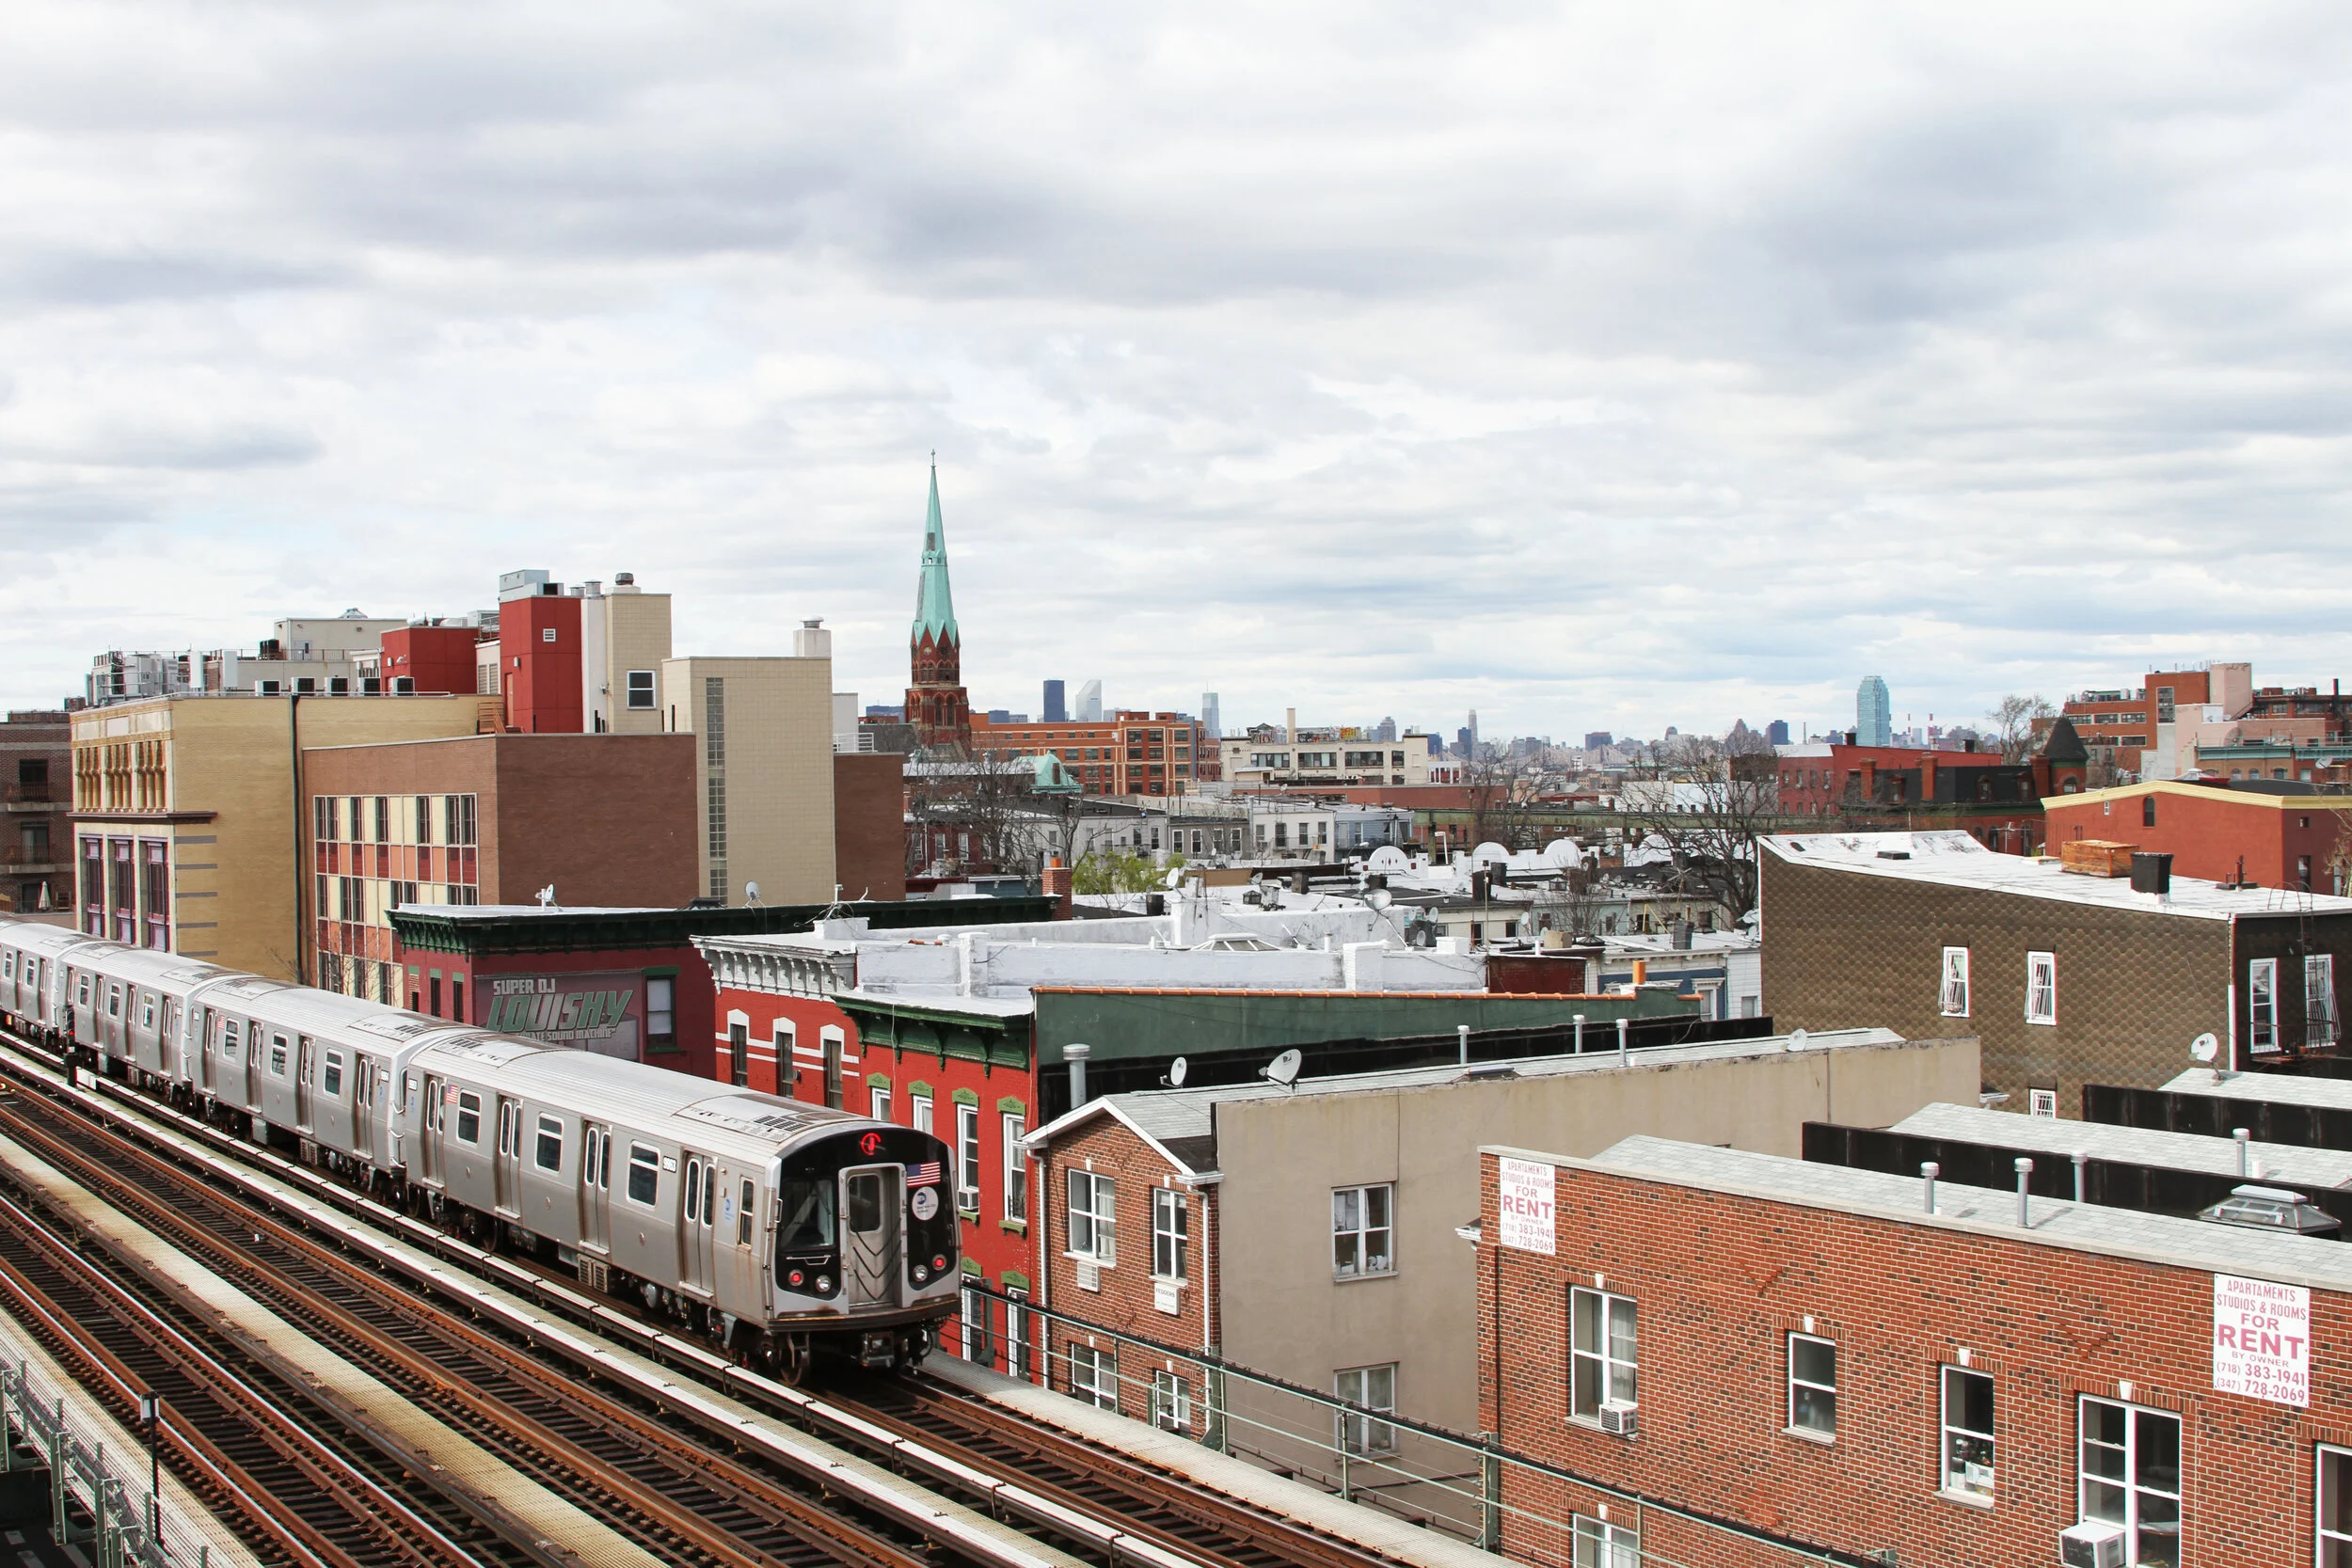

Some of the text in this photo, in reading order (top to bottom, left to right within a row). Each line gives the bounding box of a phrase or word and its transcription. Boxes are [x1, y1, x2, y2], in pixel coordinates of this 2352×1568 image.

[493, 978, 556, 995] SUPER DJ
[485, 990, 634, 1032] LOUISHY
[547, 1030, 574, 1041] SOUND
[1508, 1161, 1548, 1177] APARTAMENTS
[1502, 1172, 1553, 1190] STUDIOS & ROOMS
[1516, 1185, 1538, 1198] FOR
[1502, 1194, 1552, 1220] RENT
[1518, 1224, 1553, 1240] 383-1941
[1518, 1236, 1553, 1251] 728-2069
[2227, 1279, 2296, 1302] APARTAMENTS
[2217, 1293, 2307, 1321] STUDIOS & ROOMS
[2241, 1312, 2280, 1331] FOR
[2217, 1323, 2305, 1360] RENT
[2232, 1351, 2289, 1368] BY OWNER
[2217, 1361, 2305, 1386] (718) 383-1941
[2217, 1377, 2305, 1402] (347) 728-2069
